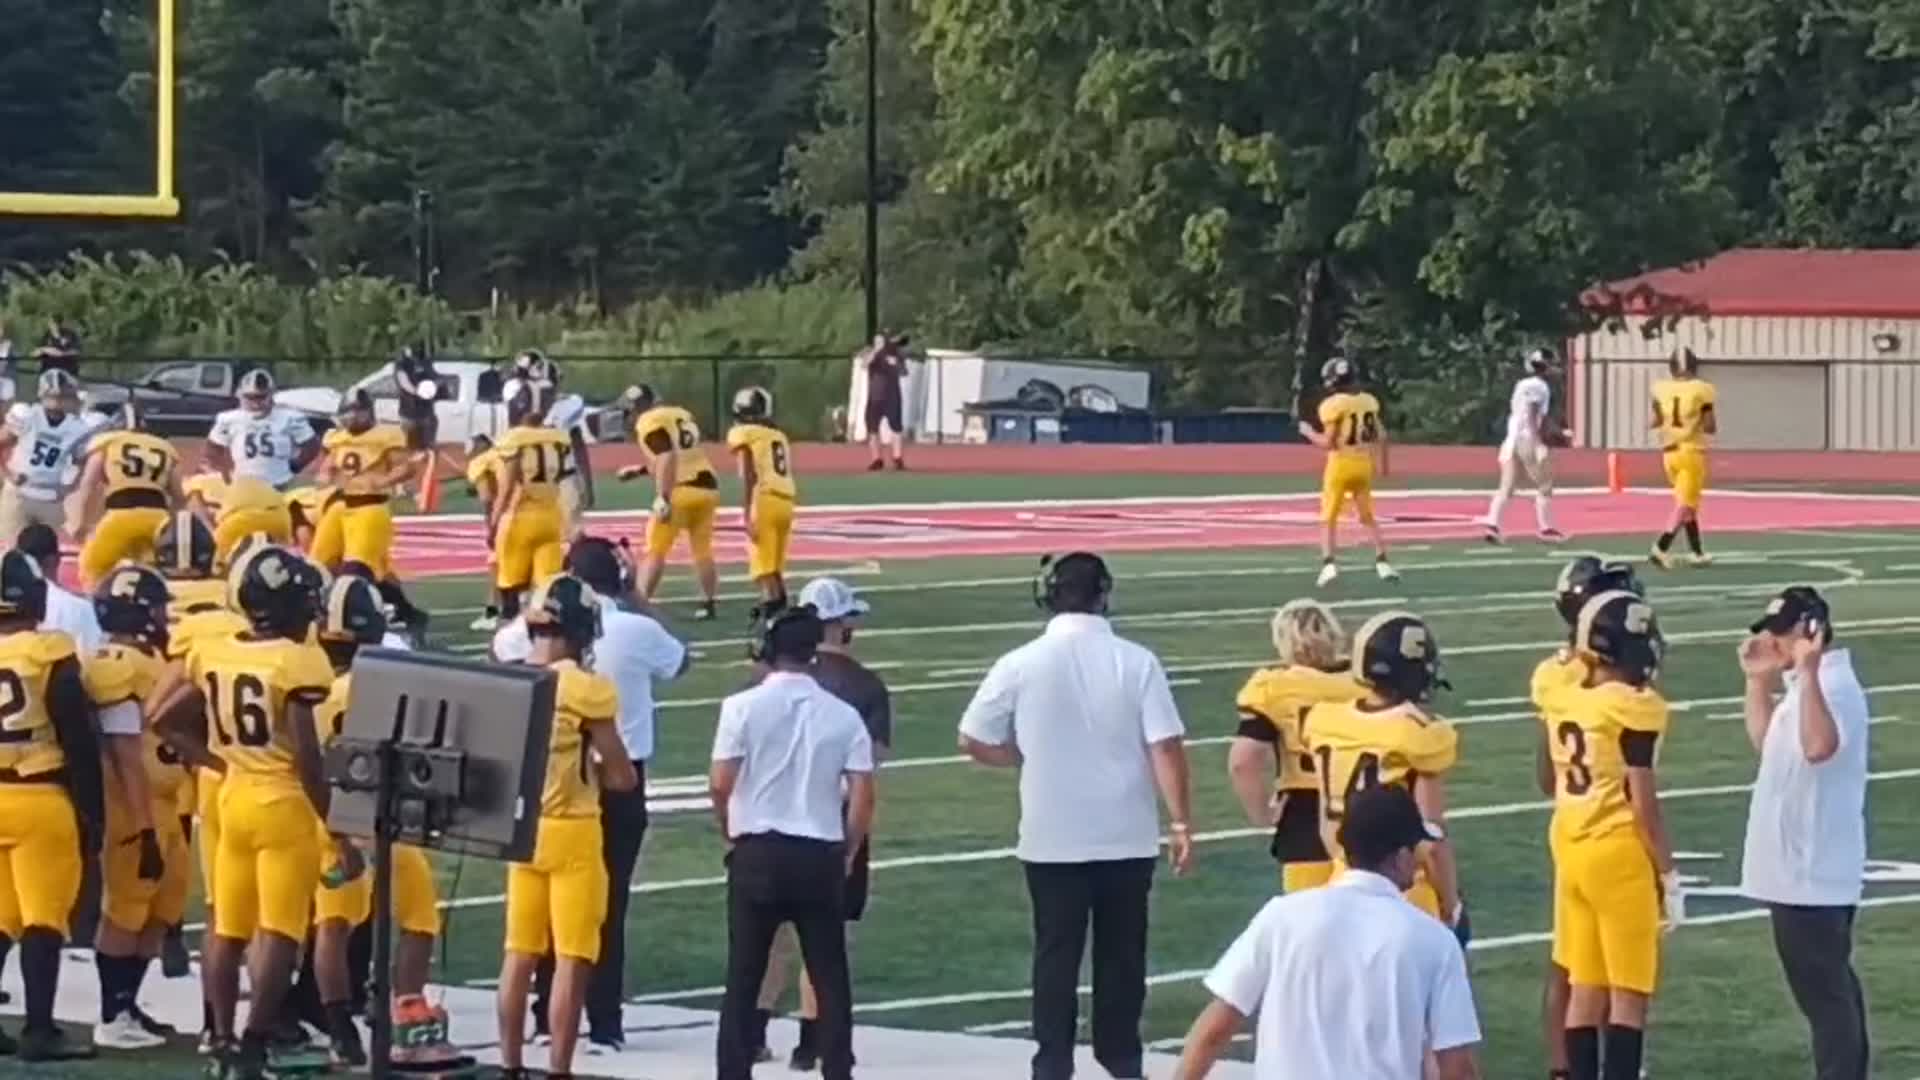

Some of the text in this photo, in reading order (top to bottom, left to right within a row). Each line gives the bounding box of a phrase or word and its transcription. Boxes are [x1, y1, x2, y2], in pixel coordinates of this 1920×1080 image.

[675, 418, 695, 450] 6
[30, 440, 61, 468] 58
[119, 443, 168, 482] 57
[771, 440, 788, 476] 8
[205, 670, 272, 747] 16
[1557, 720, 1592, 797] 3
